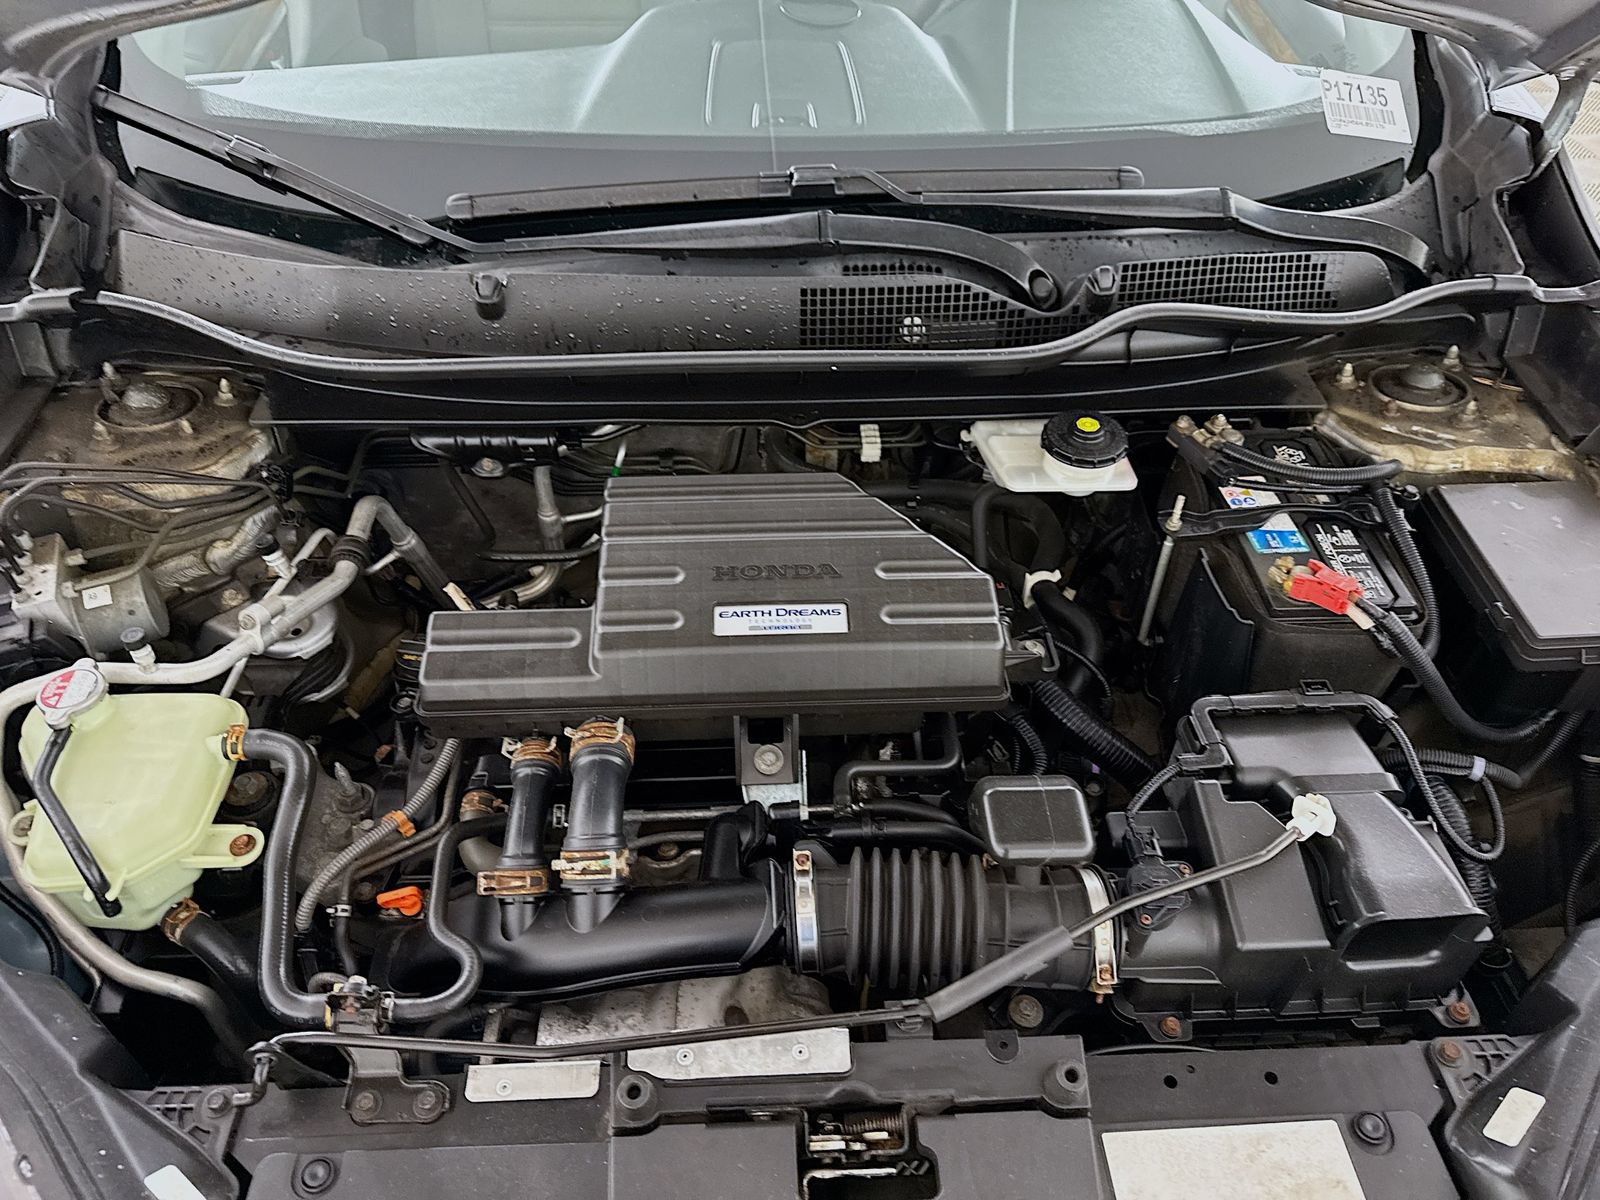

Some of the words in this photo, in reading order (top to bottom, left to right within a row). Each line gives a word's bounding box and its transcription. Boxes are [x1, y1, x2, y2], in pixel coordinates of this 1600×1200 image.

[1321, 79, 1388, 107] P17135
[712, 562, 843, 580] HONDA
[719, 610, 772, 618] EARTH
[776, 608, 842, 617] DREAMS
